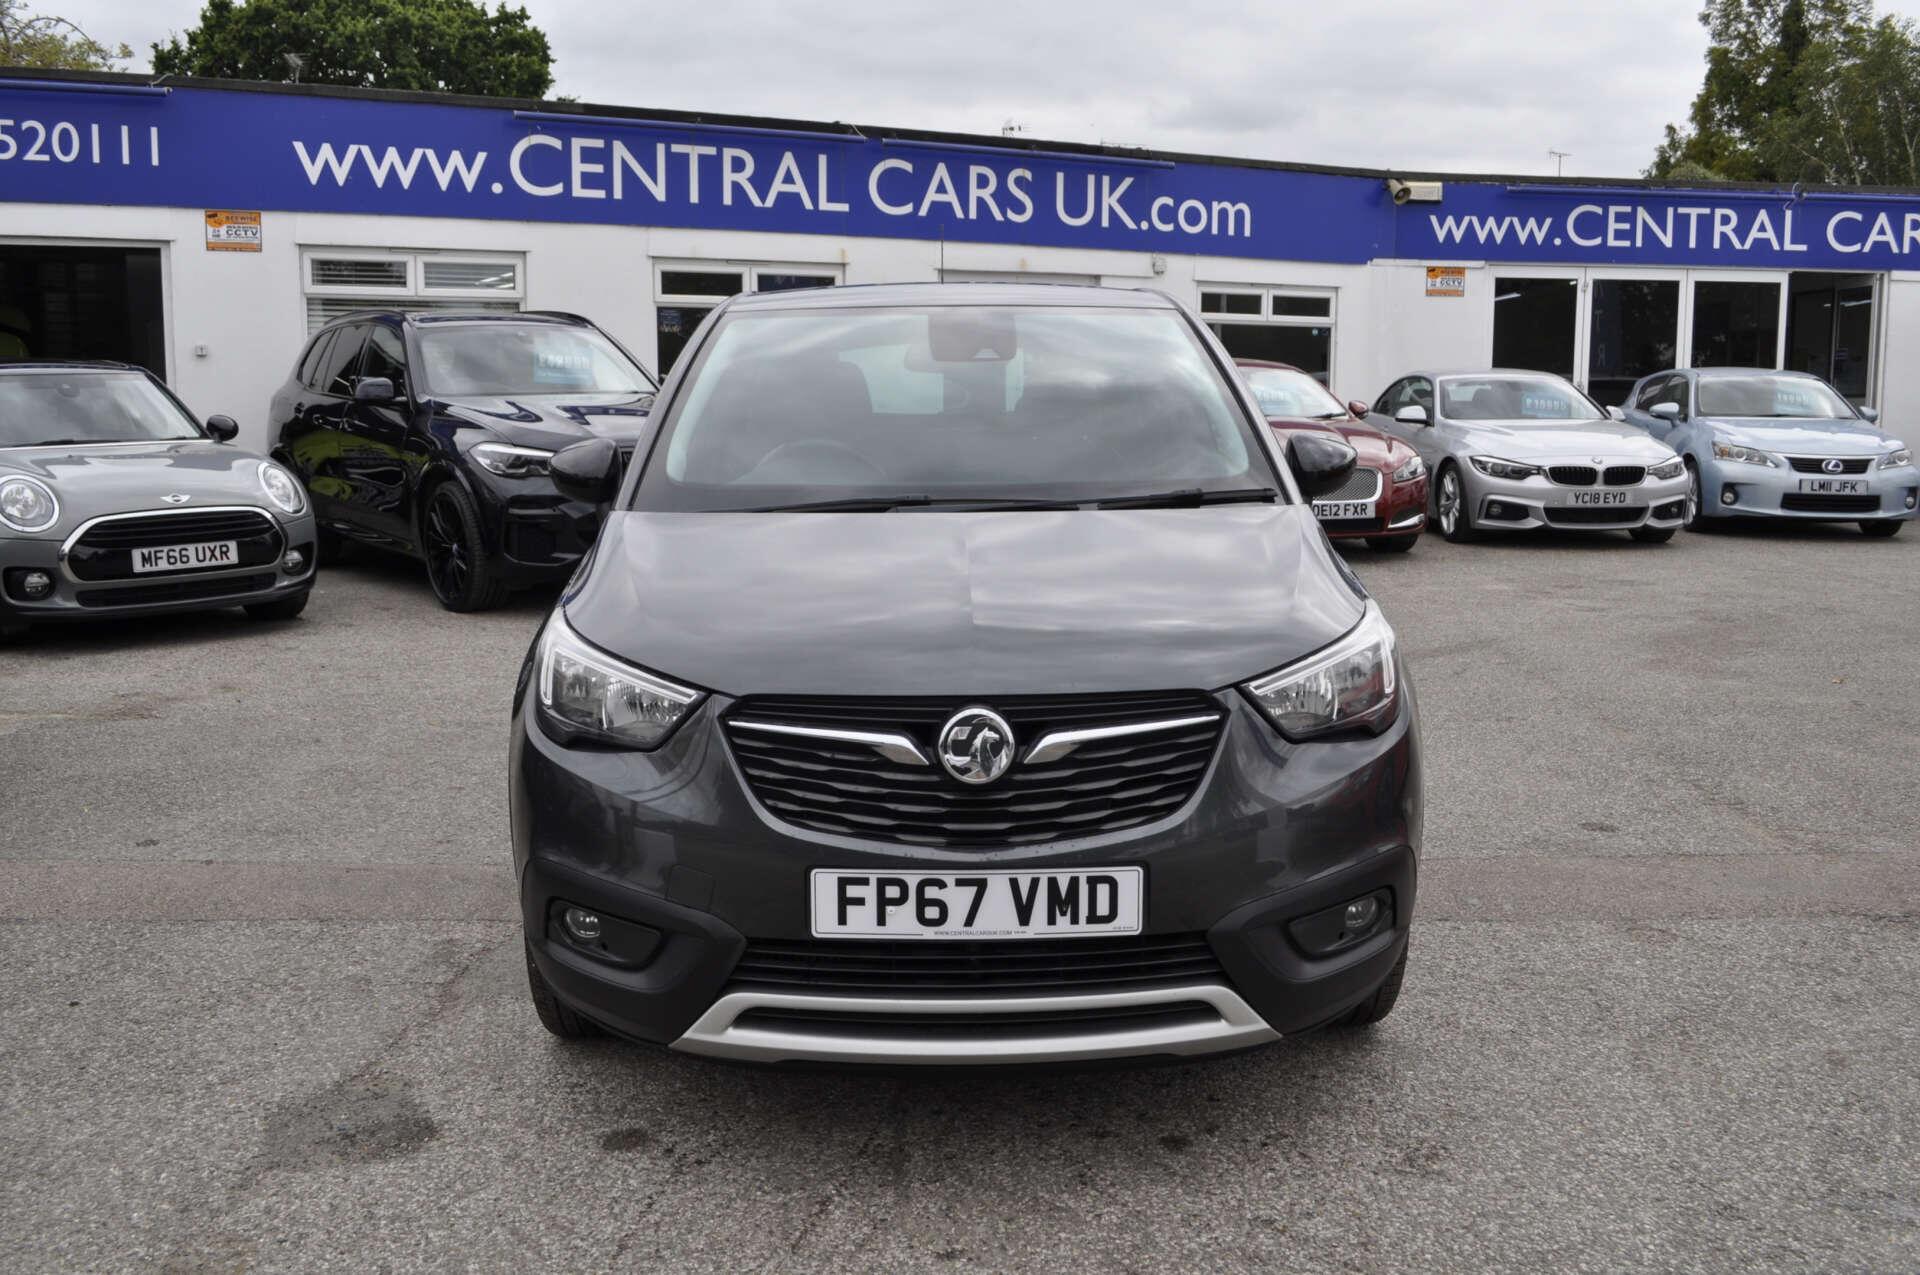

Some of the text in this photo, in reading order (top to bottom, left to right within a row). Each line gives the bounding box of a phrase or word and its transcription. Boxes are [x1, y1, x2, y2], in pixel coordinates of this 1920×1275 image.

[0, 119, 159, 167] 520111
[293, 135, 1251, 238] www.CENTRAL CARS UK.com
[226, 229, 259, 237] CCTV
[1430, 205, 1808, 252] www.CENTRAL
[1574, 491, 1626, 504] YC18 EYD
[1811, 481, 1857, 493] LM11 JFK
[1344, 503, 1367, 516] FXR
[141, 543, 230, 569] MF66 UXR
[837, 875, 1119, 928] FP67 VMD
